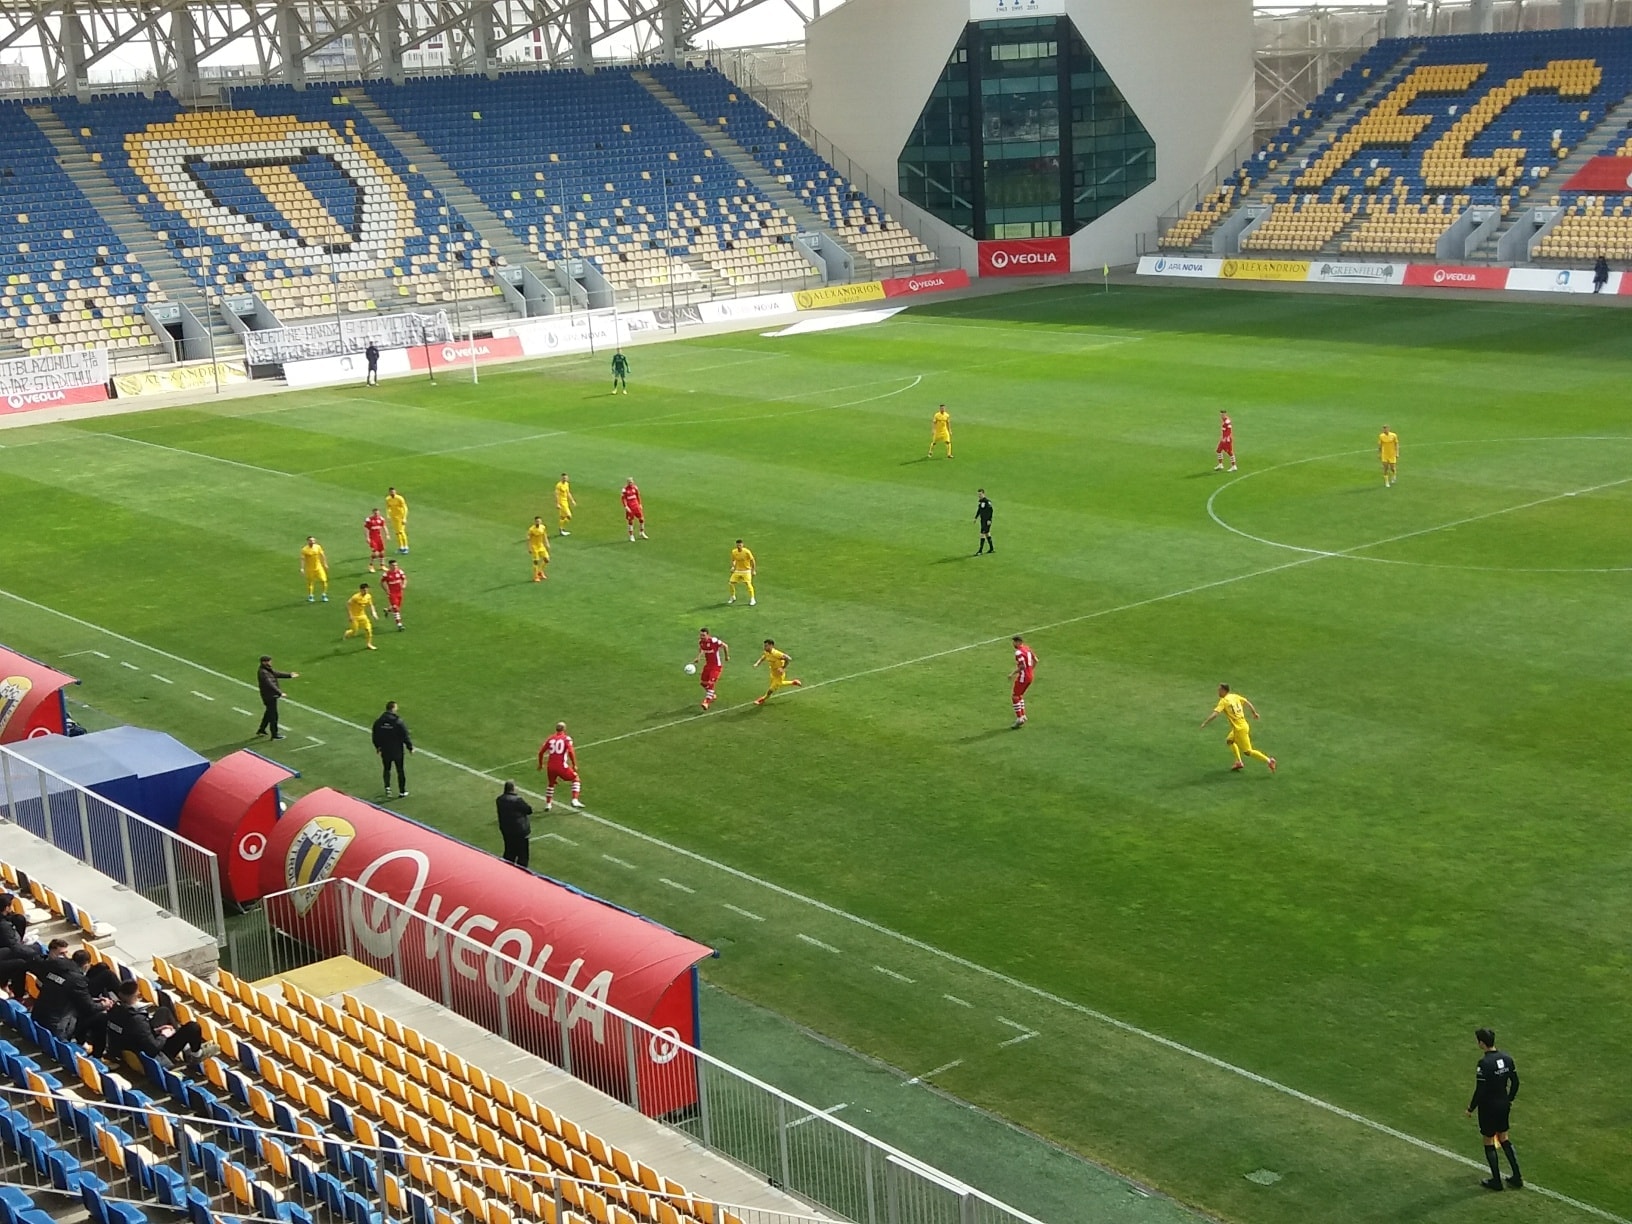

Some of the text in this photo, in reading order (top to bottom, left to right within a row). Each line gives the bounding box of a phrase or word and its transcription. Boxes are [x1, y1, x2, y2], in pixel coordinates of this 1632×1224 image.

[1009, 252, 1057, 265] VEOLIA
[1182, 263, 1203, 272] NOVA
[1239, 262, 1307, 273] ALEXANDRION
[1330, 265, 1384, 276] GREENFIELD
[918, 278, 945, 289] VEOLIA
[1446, 273, 1476, 282] VEOLIA
[813, 283, 881, 300] ALEXANDRION
[455, 345, 490, 359] VEOLIA
[23, 390, 66, 404] VEOLIA
[548, 738, 565, 755] 30
[426, 891, 614, 1045] VEOLIA
